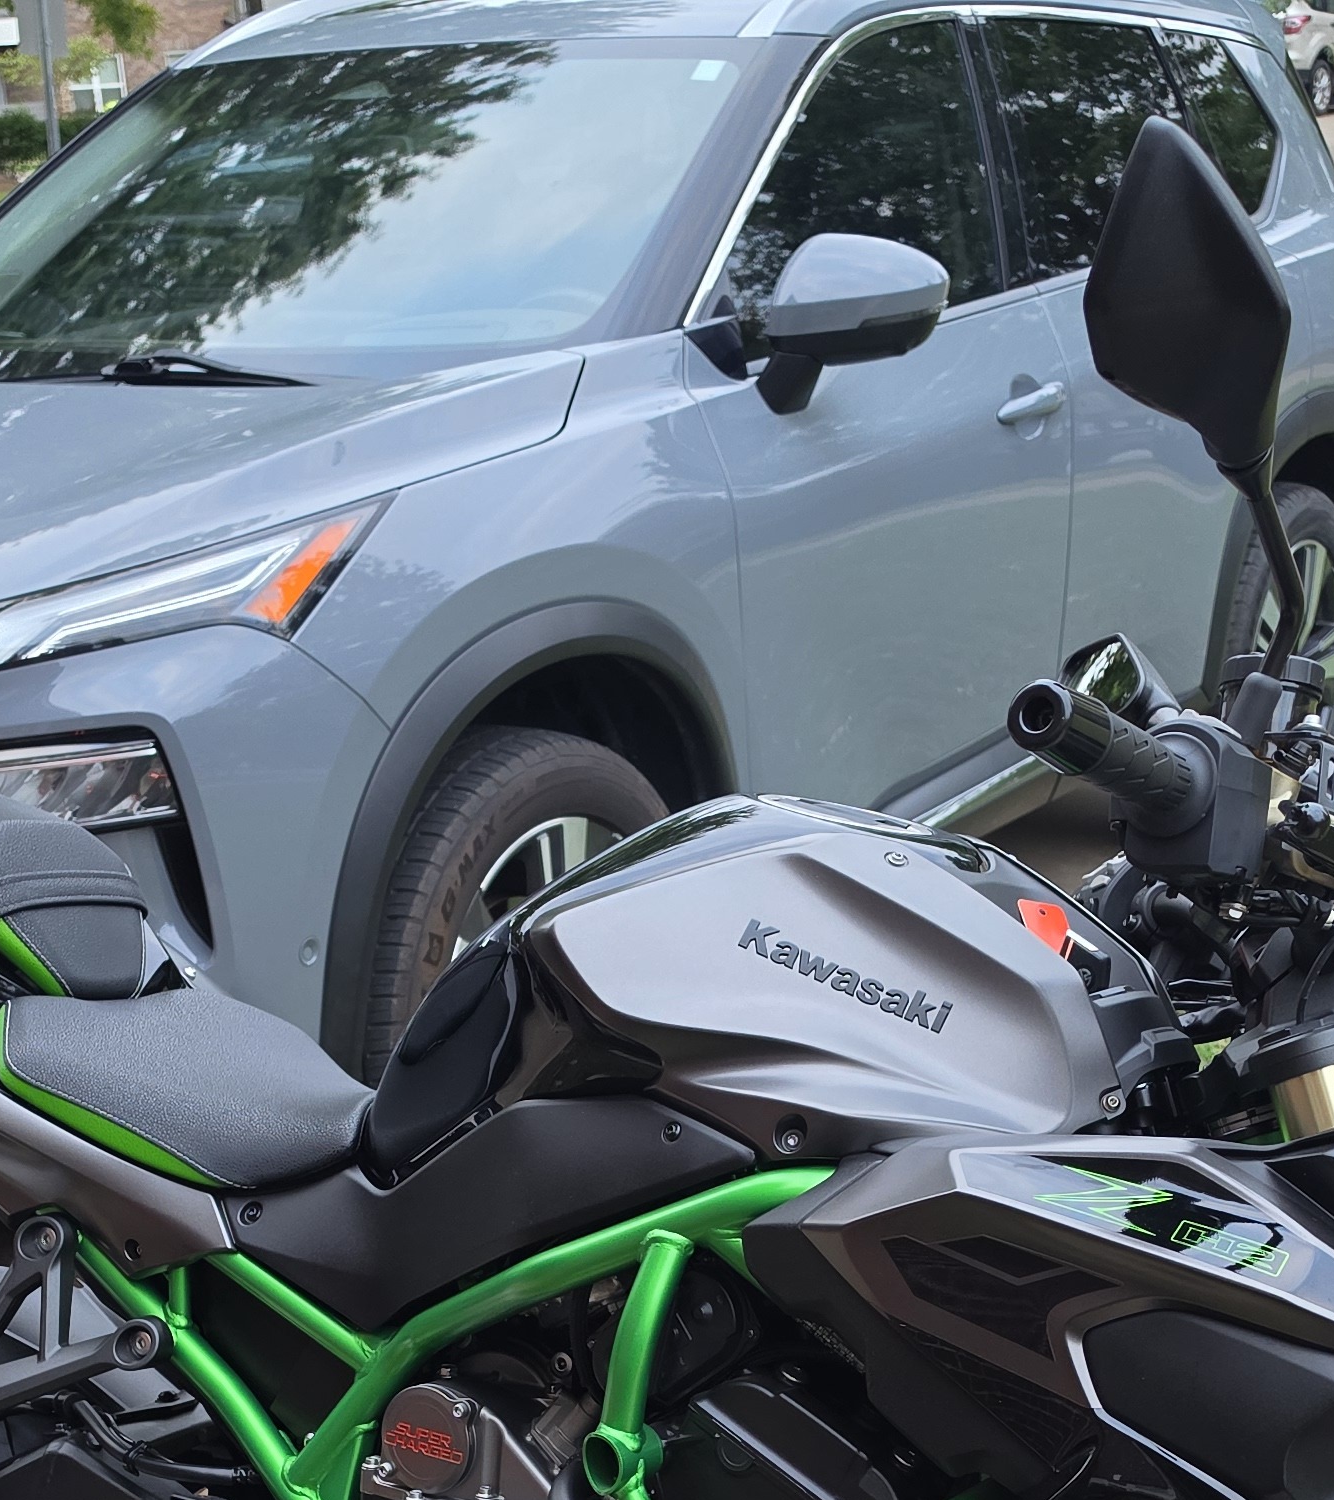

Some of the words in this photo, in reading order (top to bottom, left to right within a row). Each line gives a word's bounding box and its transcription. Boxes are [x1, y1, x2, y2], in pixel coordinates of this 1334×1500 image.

[737, 918, 954, 1034] Kawasaki
[383, 1431, 464, 1466] CHARGED
[392, 1421, 452, 1448] SUPER
